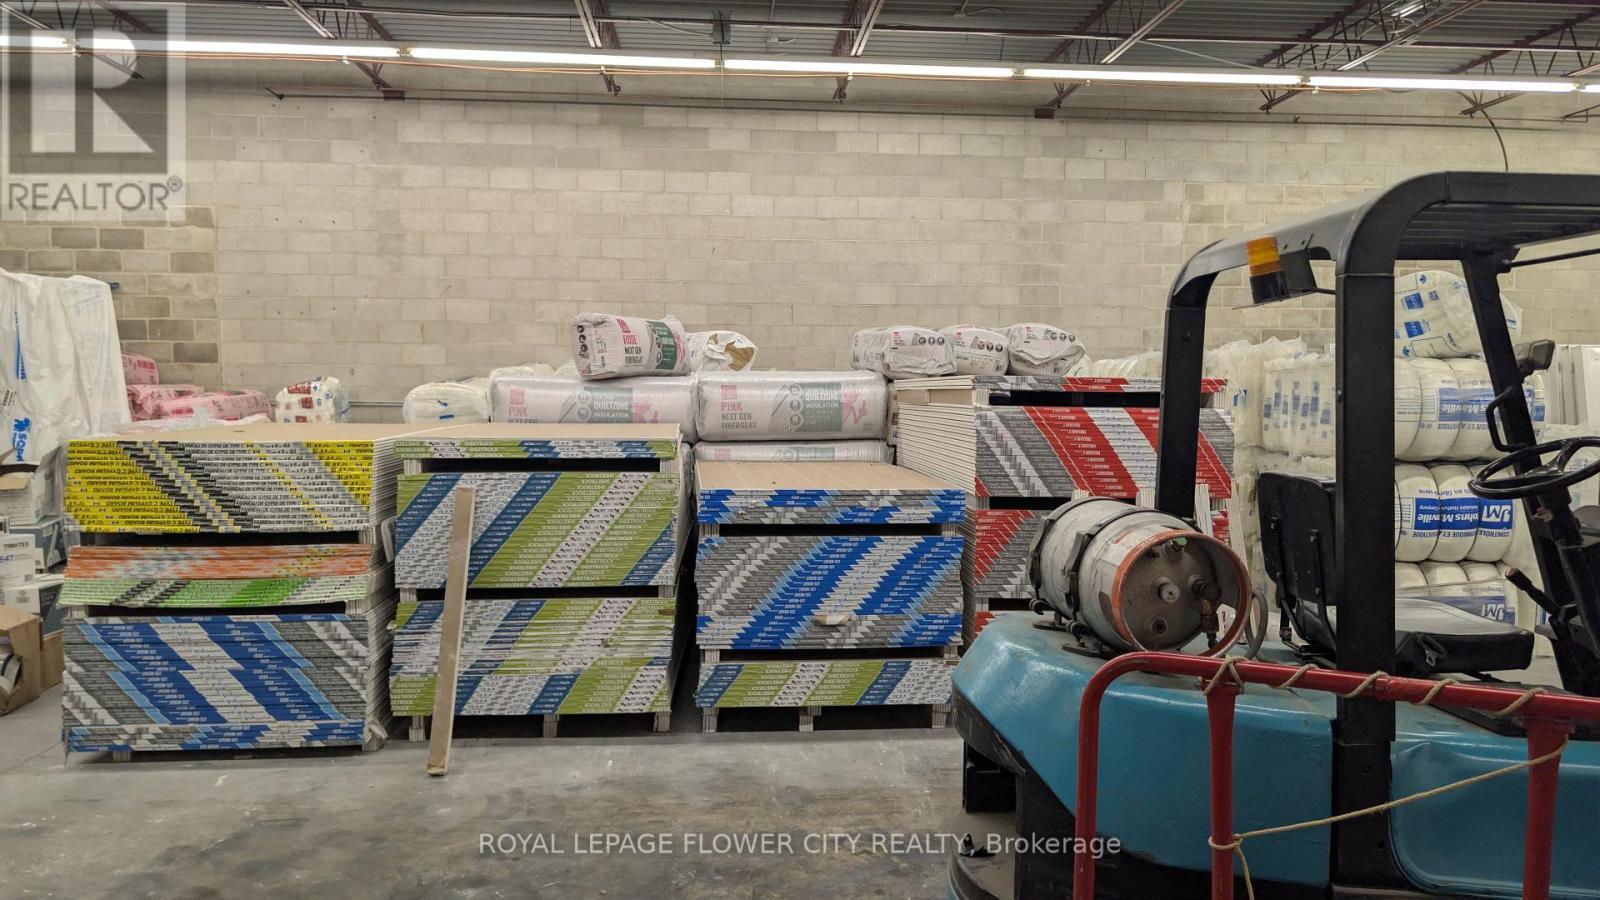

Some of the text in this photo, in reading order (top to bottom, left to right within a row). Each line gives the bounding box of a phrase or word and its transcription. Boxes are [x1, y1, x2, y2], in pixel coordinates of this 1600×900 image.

[508, 406, 528, 416] PINK
[721, 402, 742, 412] PINK
[722, 412, 752, 421] NEXT GEN
